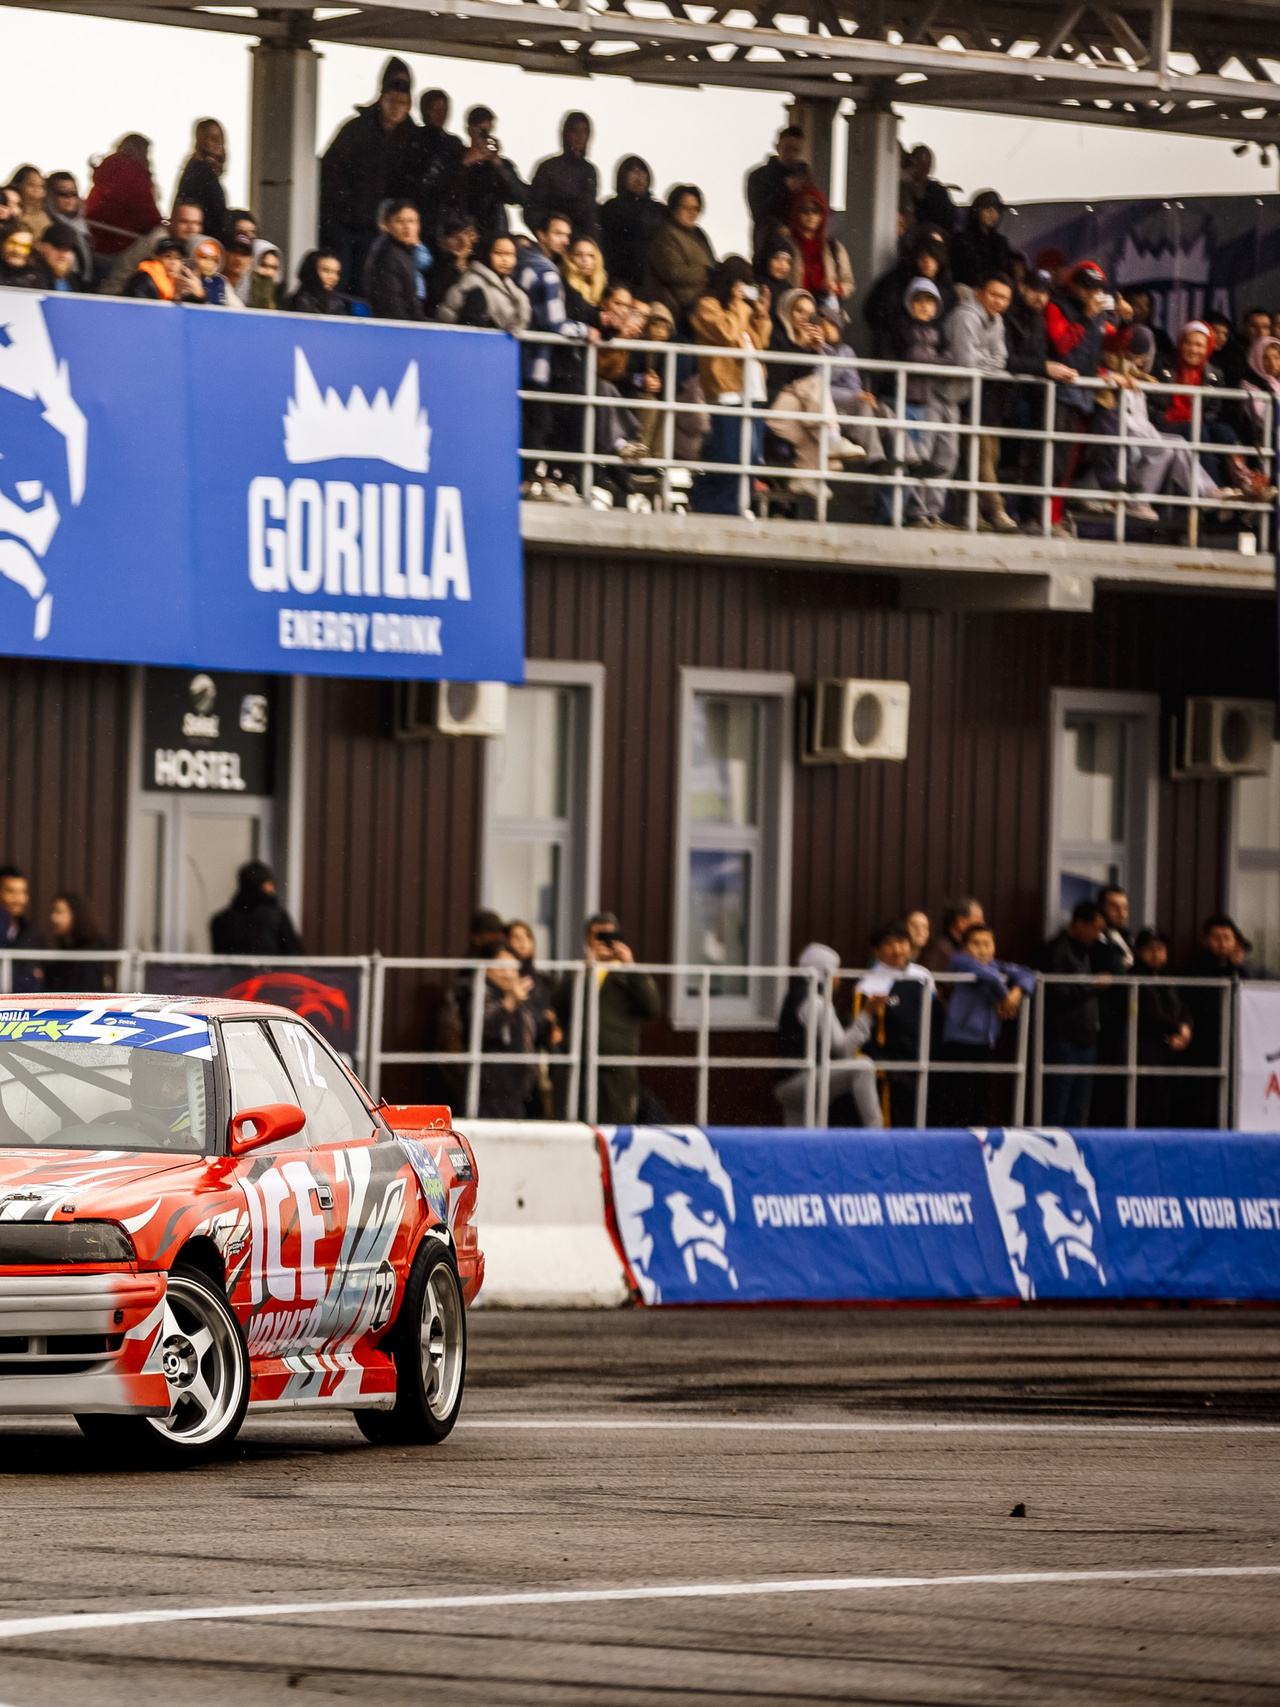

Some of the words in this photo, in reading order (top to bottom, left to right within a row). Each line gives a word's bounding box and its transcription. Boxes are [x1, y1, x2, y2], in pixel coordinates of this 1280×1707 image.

[248, 475, 472, 601] GORILLA
[278, 607, 370, 653] ENERGY
[371, 612, 443, 656] DRINK
[154, 747, 246, 791] HOSTEL
[281, 1022, 328, 1090] 72
[238, 1161, 326, 1305] ICE
[752, 1194, 827, 1228] POWER
[827, 1193, 884, 1227] YOUR
[883, 1192, 973, 1226] INSTINCT
[1116, 1196, 1184, 1228] POWER
[1184, 1196, 1238, 1229] YOUR
[370, 1271, 396, 1324] 72
